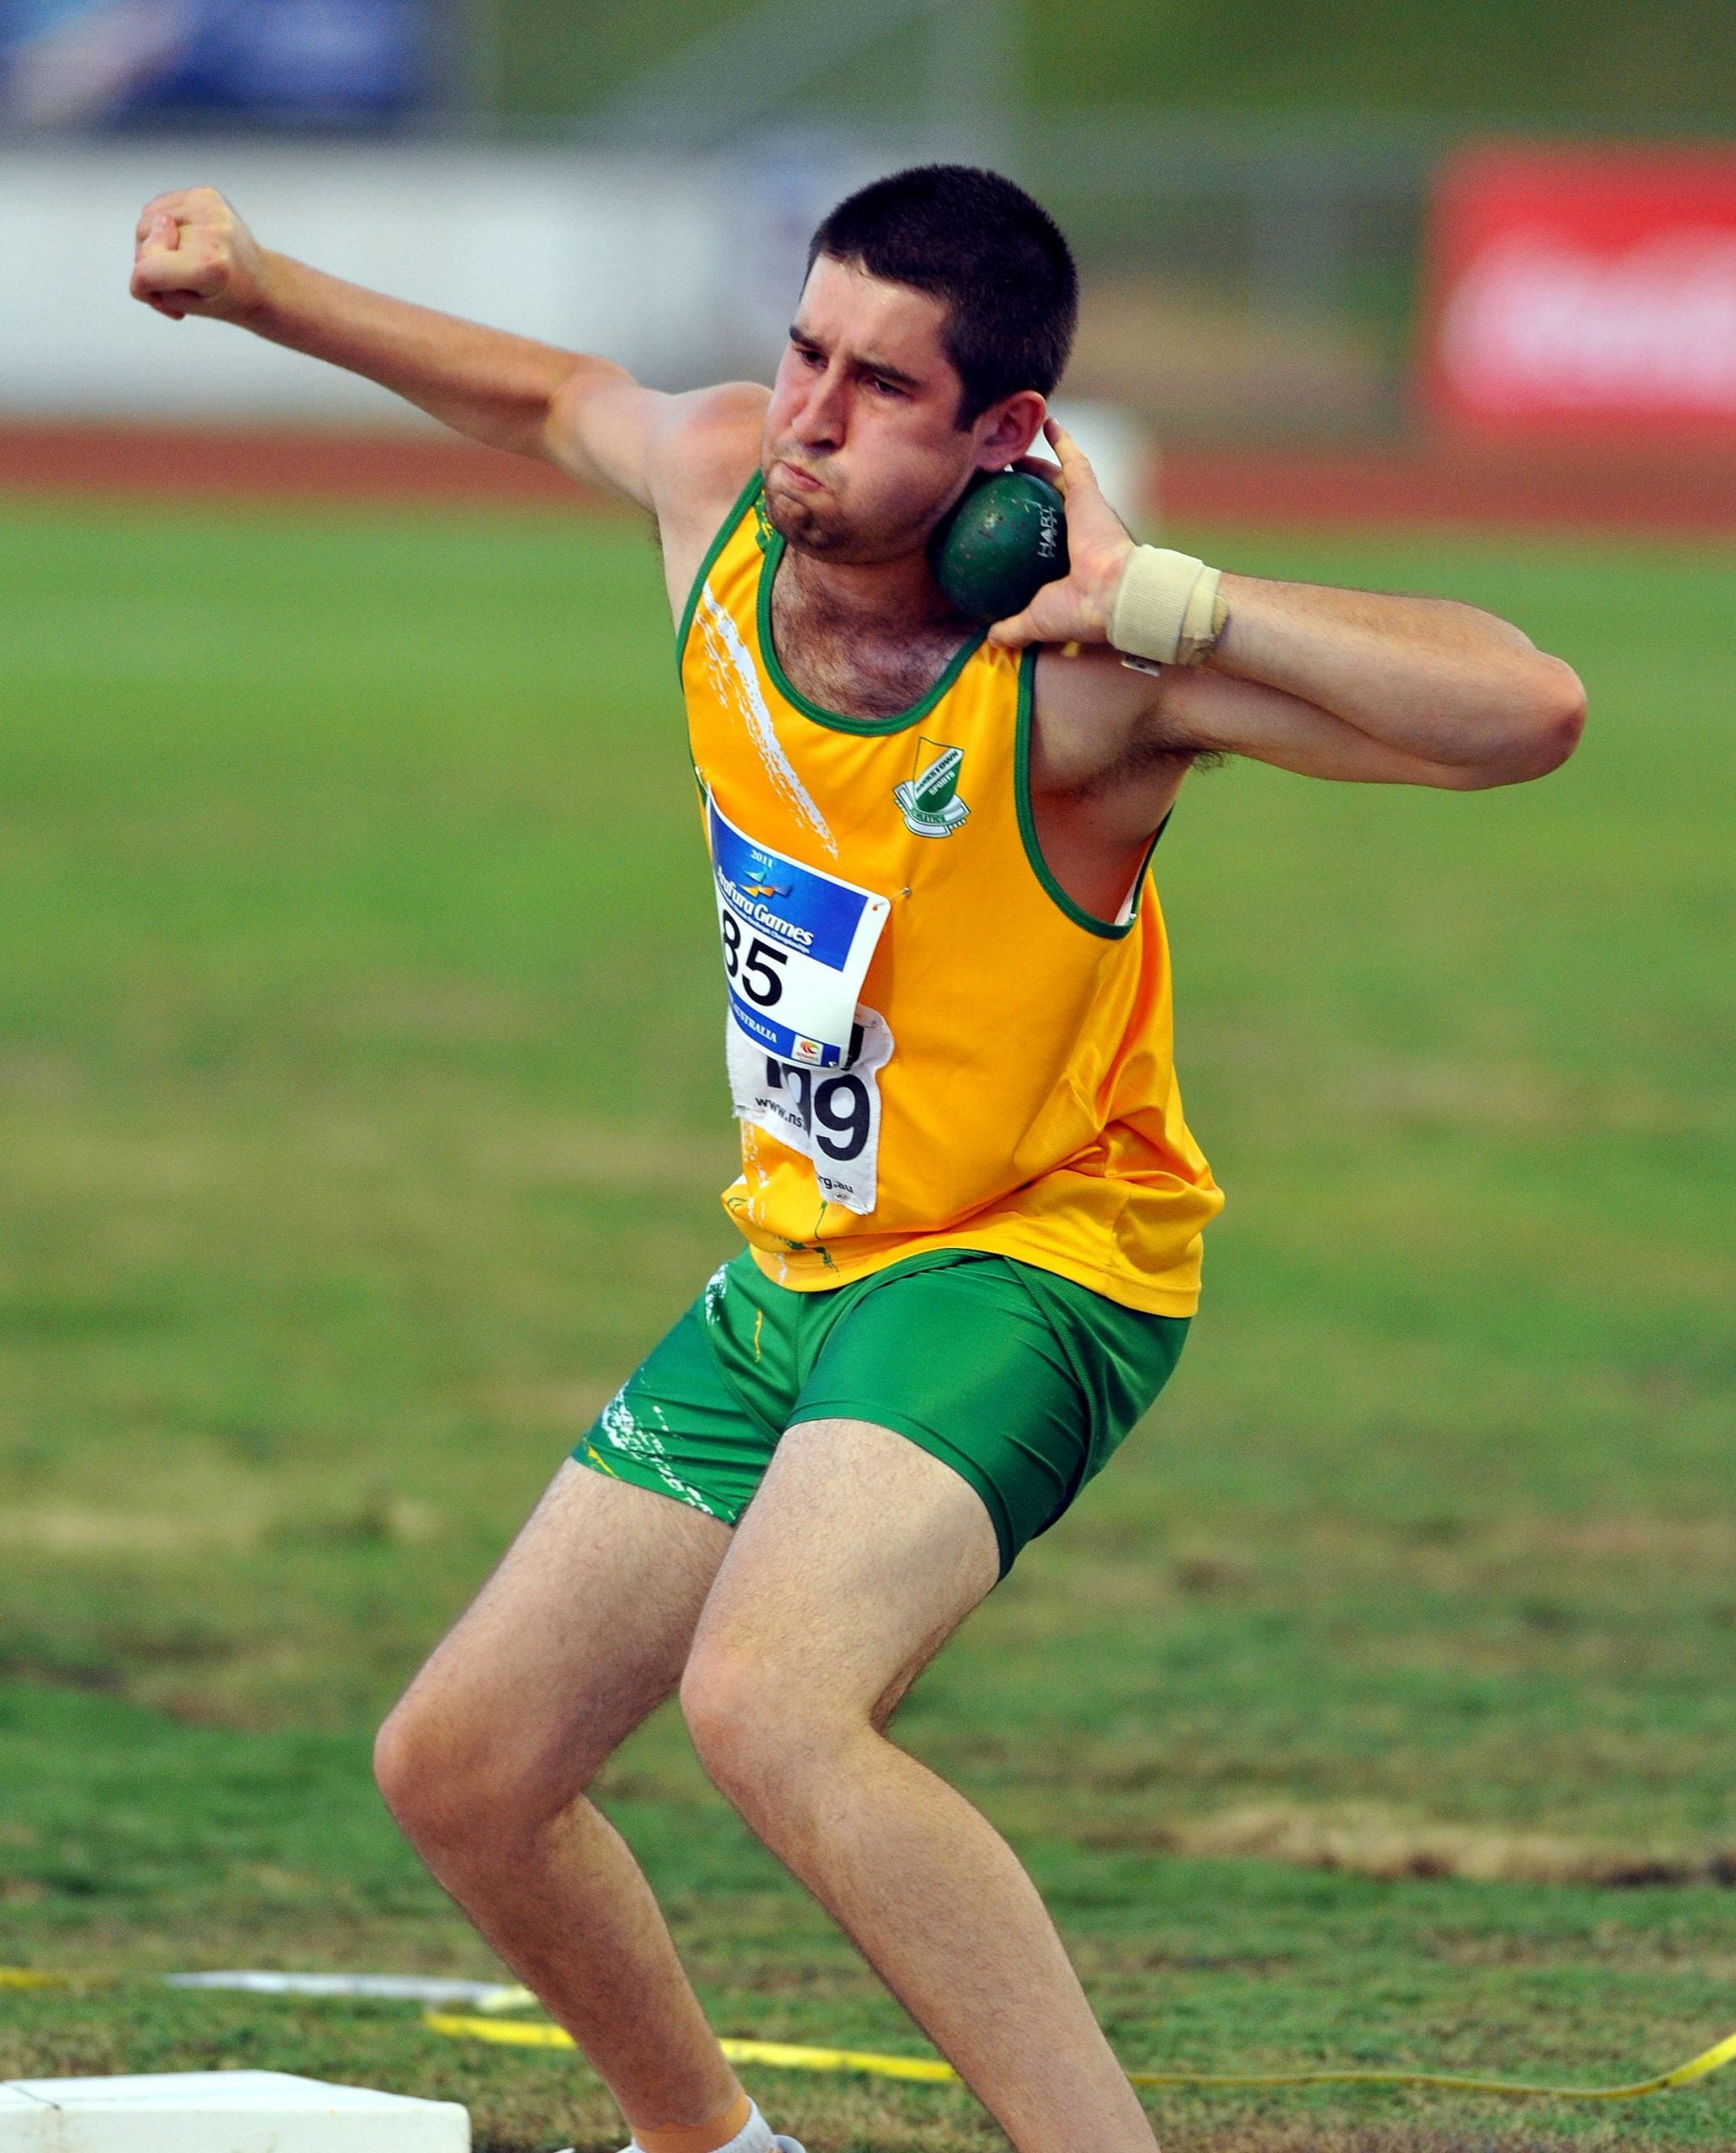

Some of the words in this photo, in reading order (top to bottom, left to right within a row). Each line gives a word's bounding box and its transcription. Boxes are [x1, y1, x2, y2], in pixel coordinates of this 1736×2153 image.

[750, 849, 774, 868] 2011
[754, 903, 815, 946] Games
[729, 990, 777, 1043] USTRALIA
